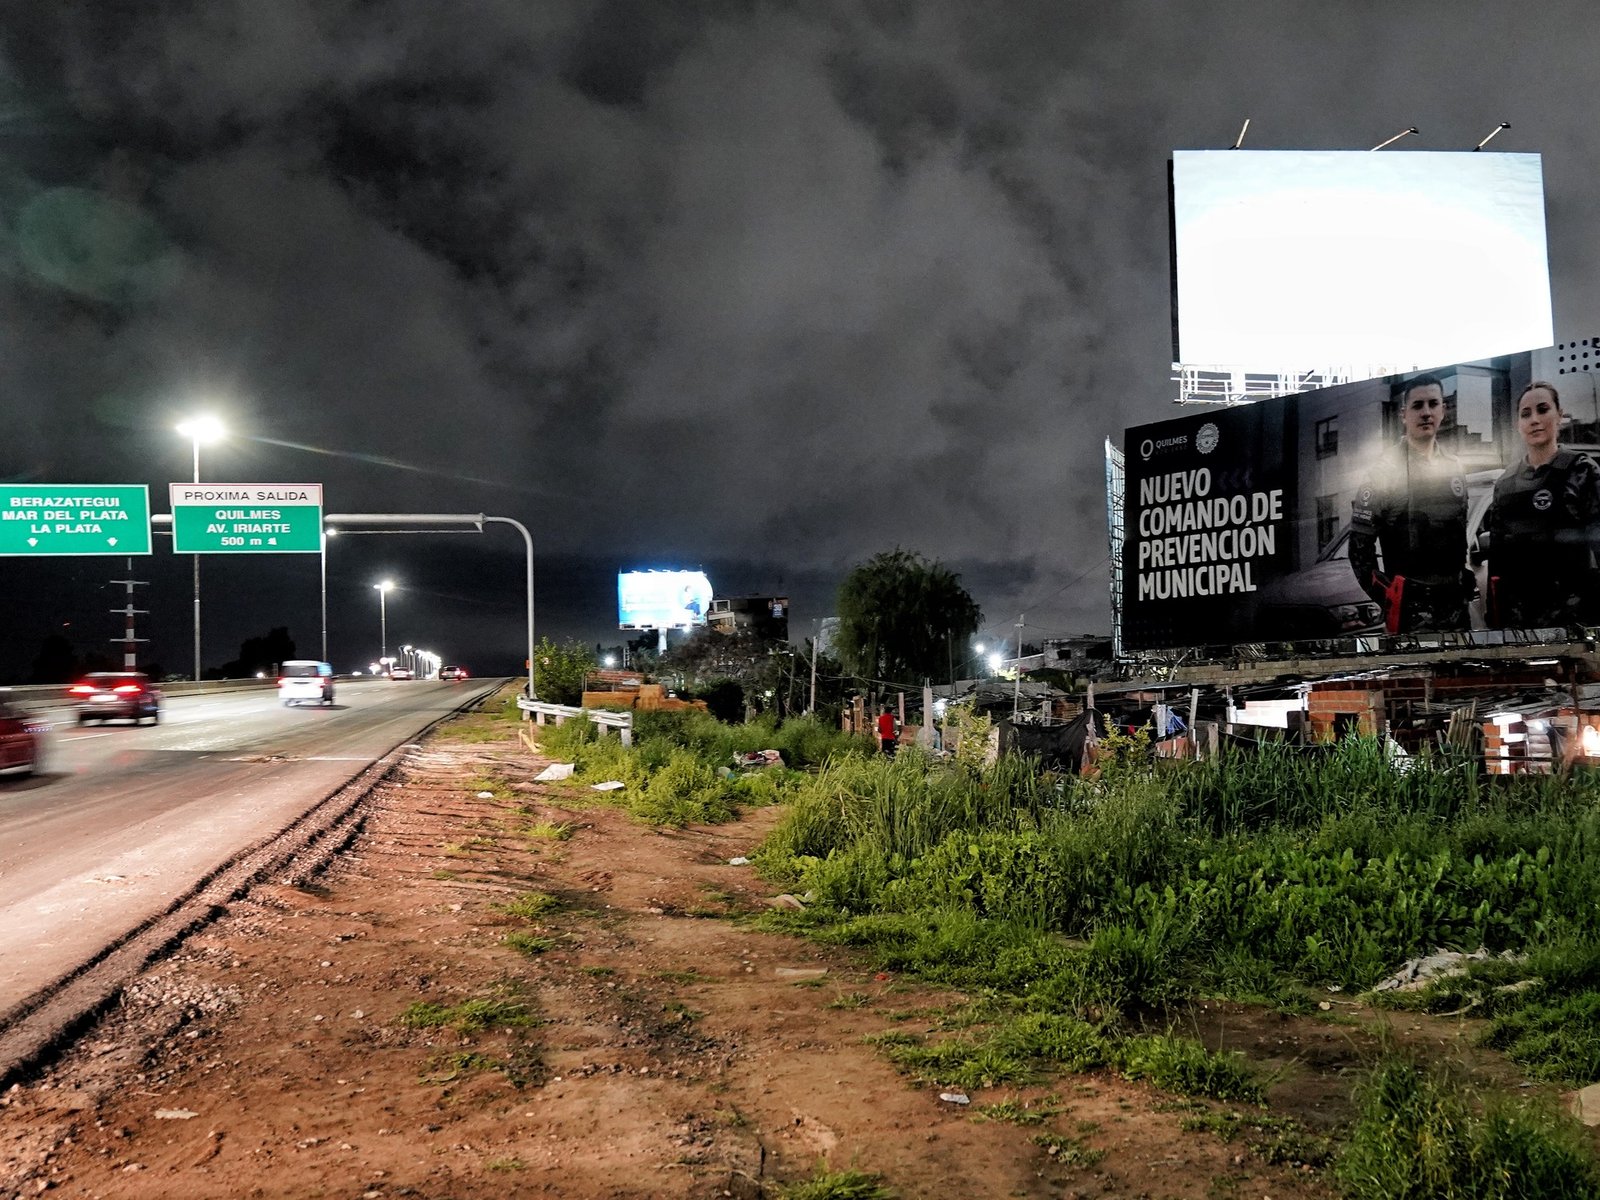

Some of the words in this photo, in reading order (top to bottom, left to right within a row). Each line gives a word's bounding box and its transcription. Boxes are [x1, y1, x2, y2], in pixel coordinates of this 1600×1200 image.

[1156, 435, 1188, 450] QUILMES
[1140, 467, 1212, 506] NUEVO
[184, 491, 250, 501] PROXIMA
[257, 491, 308, 501] SALIDA
[10, 497, 120, 507] BERAZATEGUI
[2, 511, 38, 521] MAR
[43, 511, 75, 521] DEL
[80, 511, 128, 521] PLATA
[215, 510, 281, 520] QUILMES
[1139, 494, 1248, 538] COMANDO
[1252, 489, 1283, 523] DE
[31, 524, 51, 534] LA
[56, 524, 102, 534] PLATA
[206, 523, 228, 534] AV.
[233, 523, 291, 533] IRIARTE
[221, 536, 244, 546] 500
[250, 537, 262, 546] m
[1139, 520, 1276, 569] PREVENCIÓN
[1138, 561, 1257, 601] MUNICIPAL
